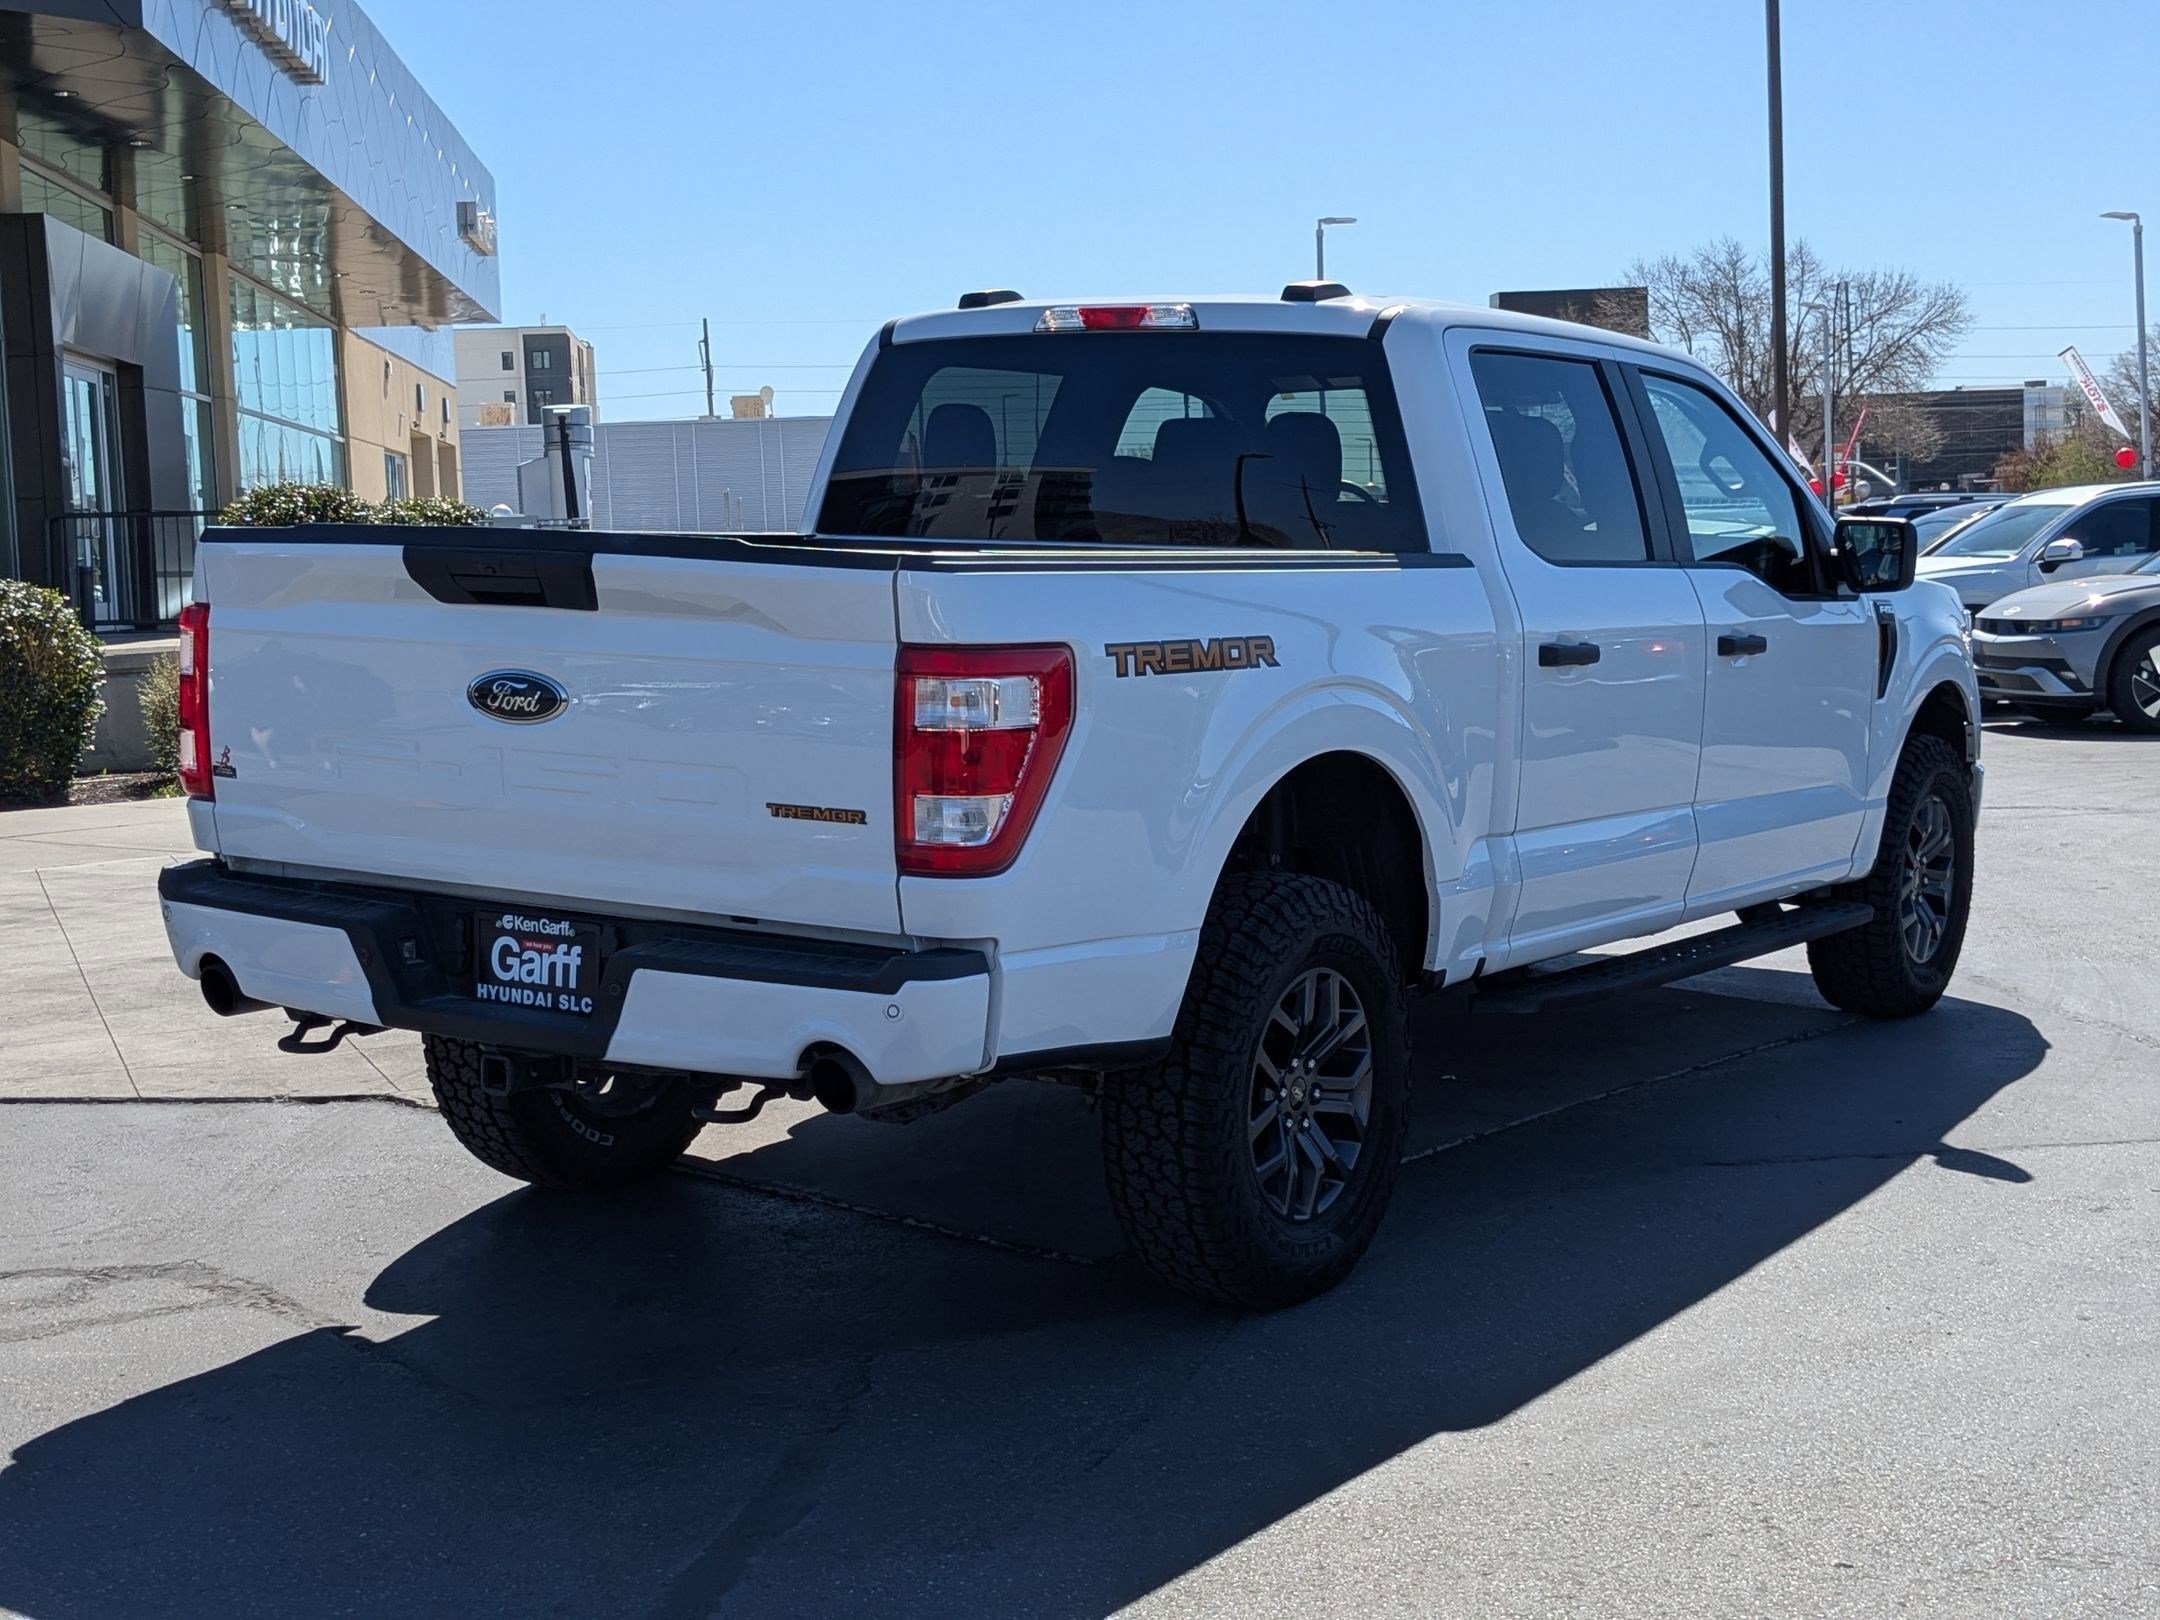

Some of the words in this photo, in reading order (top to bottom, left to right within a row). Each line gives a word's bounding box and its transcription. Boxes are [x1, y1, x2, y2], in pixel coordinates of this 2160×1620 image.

[1104, 635, 1281, 678] TREMOR
[487, 680, 541, 712] Ford
[766, 802, 868, 825] TREMOR
[491, 935, 582, 989] Garff
[477, 983, 552, 1008] HYUNDAI
[558, 994, 593, 1013] SLC
